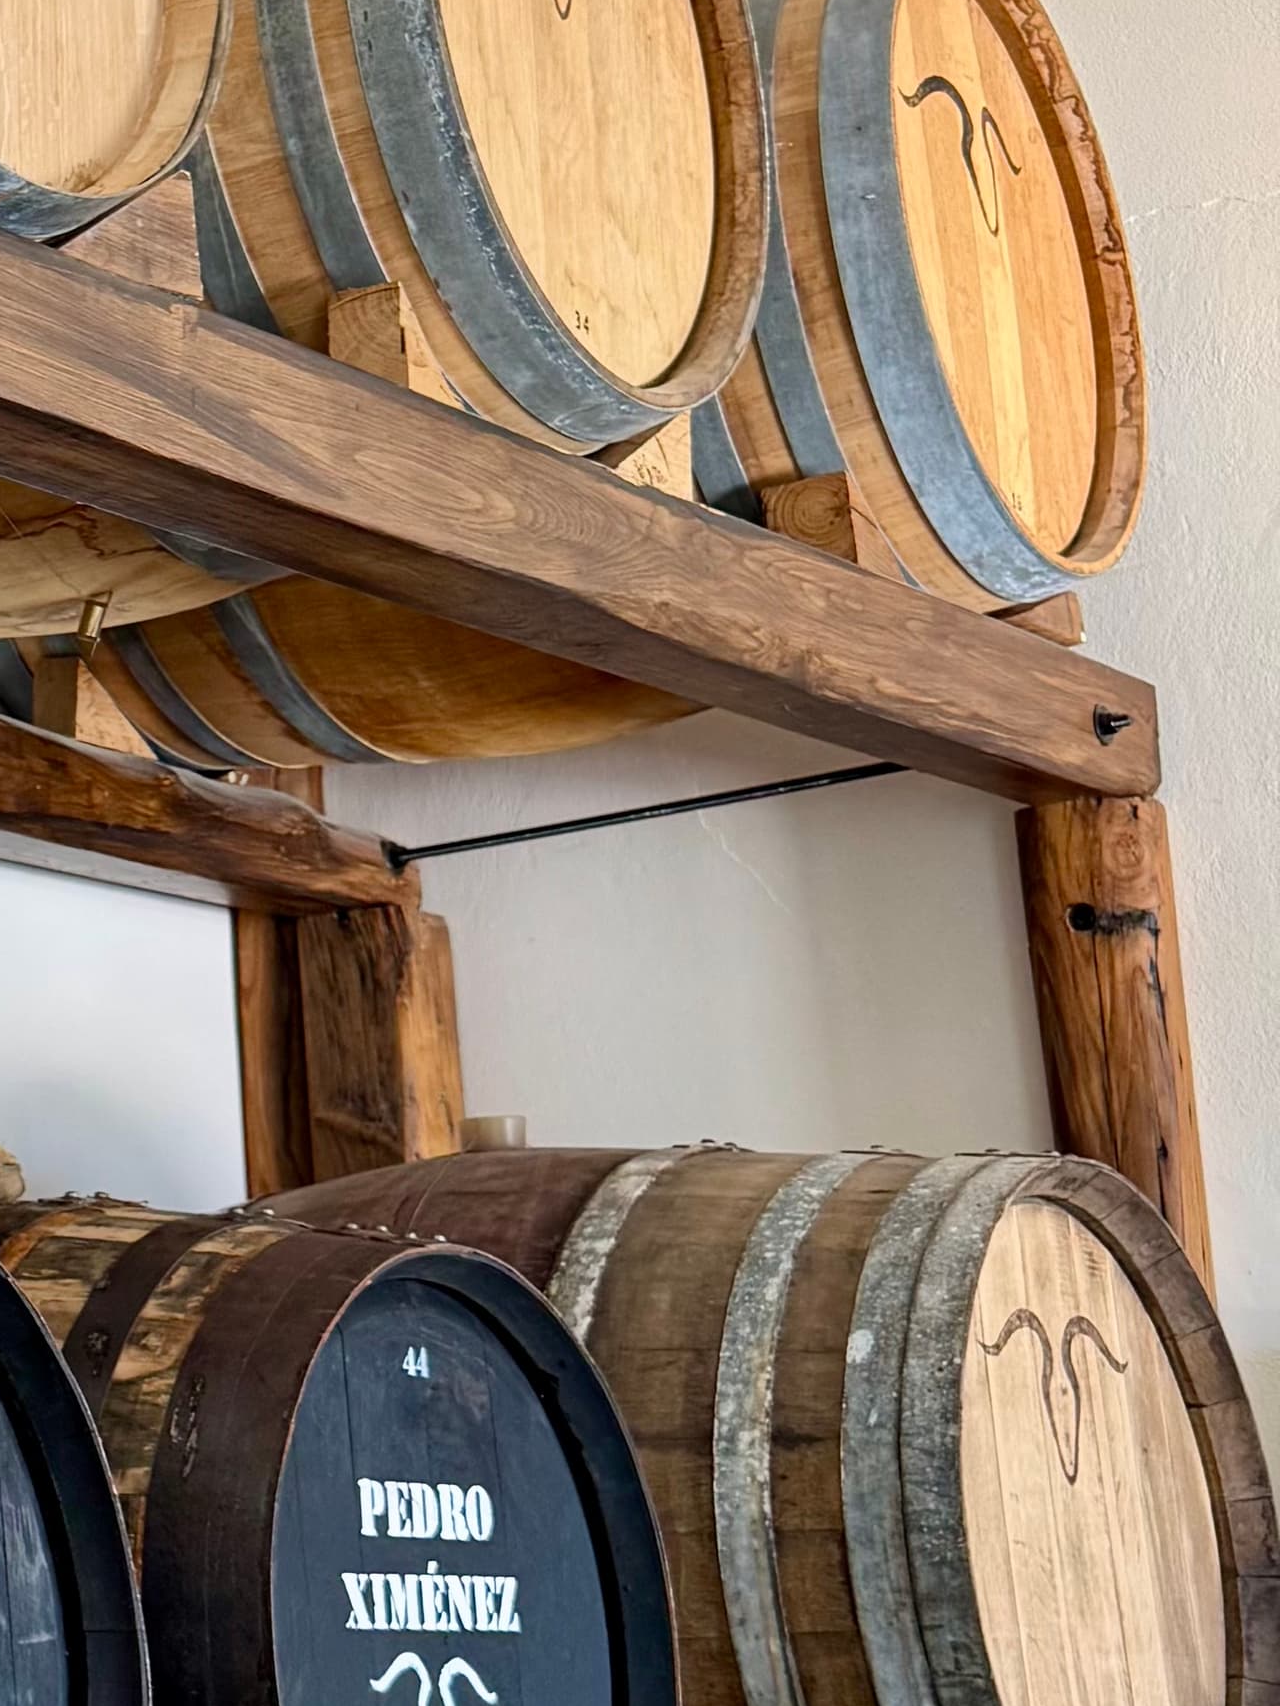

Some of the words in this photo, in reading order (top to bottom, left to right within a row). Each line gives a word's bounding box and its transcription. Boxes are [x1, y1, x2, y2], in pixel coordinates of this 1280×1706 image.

[402, 1346, 430, 1379] 44
[357, 1477, 494, 1542] PEDRO
[340, 1560, 522, 1634] XIMÉNEZ
